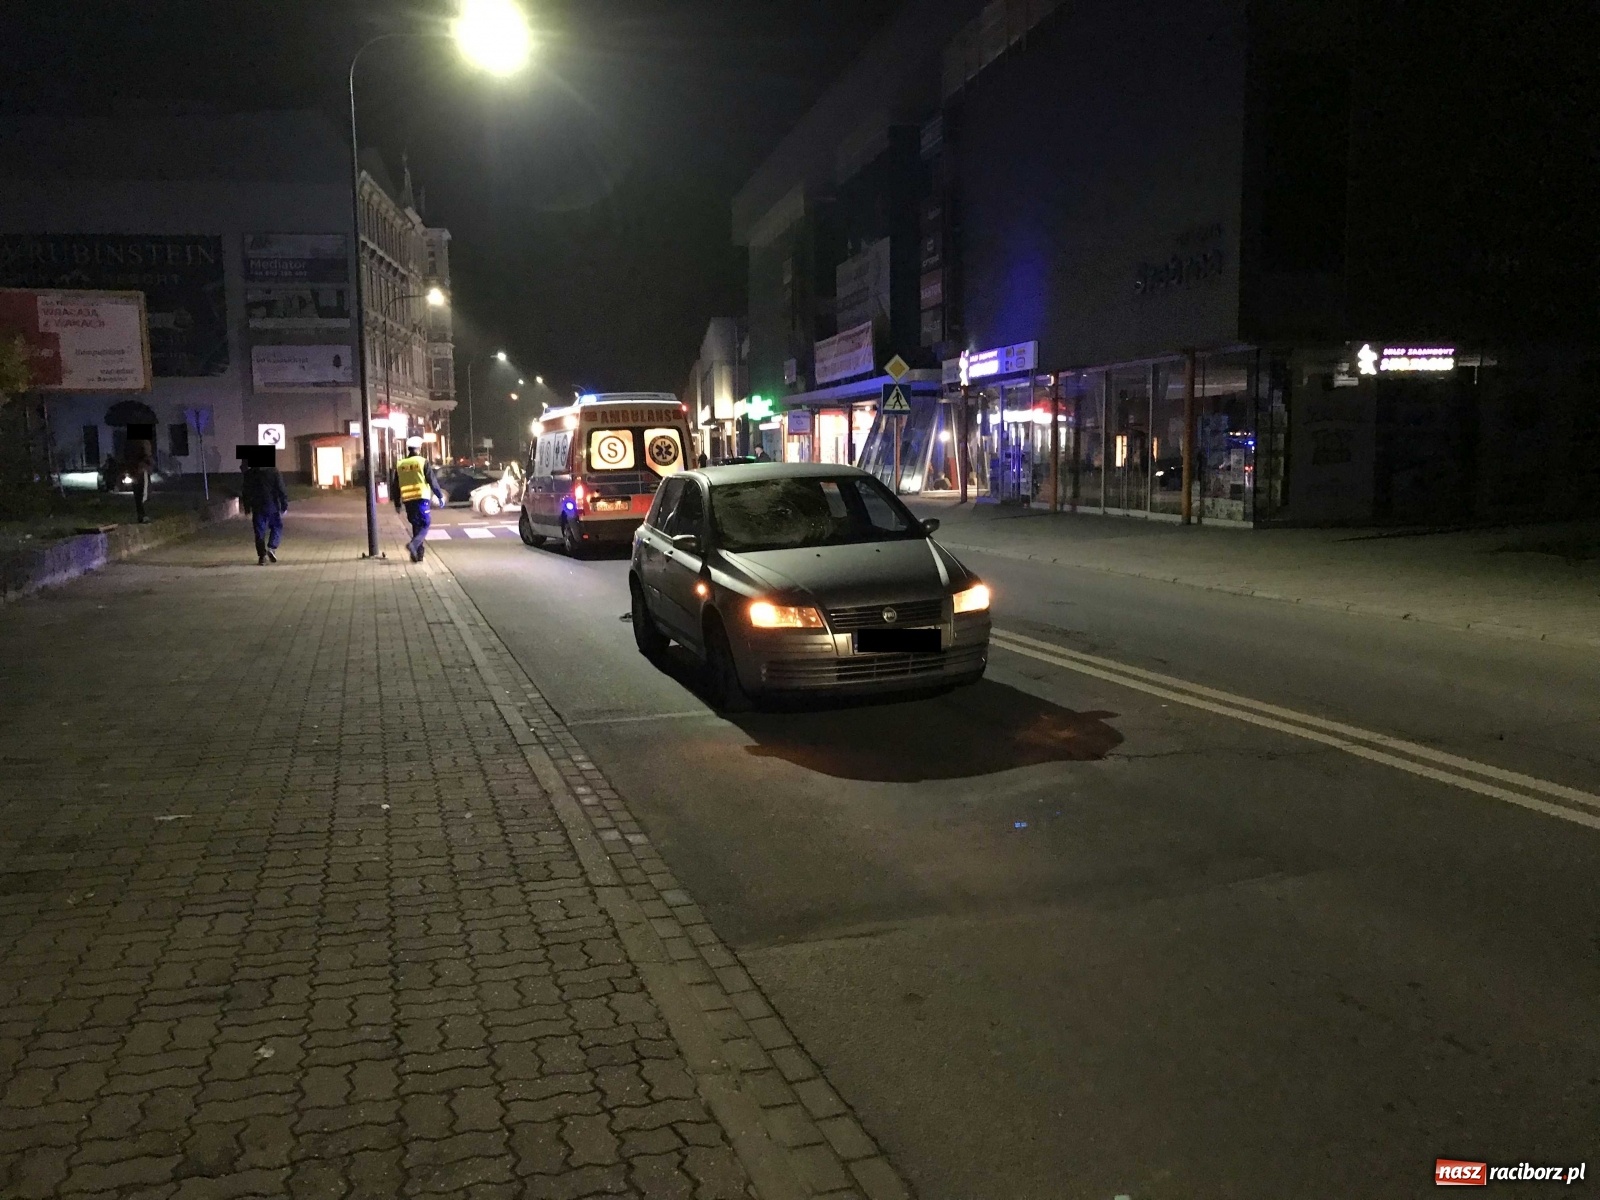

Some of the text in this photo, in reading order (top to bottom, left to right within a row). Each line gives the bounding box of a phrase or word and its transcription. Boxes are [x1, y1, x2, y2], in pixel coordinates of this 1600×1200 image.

[250, 258, 306, 269] Mediator
[600, 409, 673, 424] AMBULANS
[607, 442, 618, 459] S
